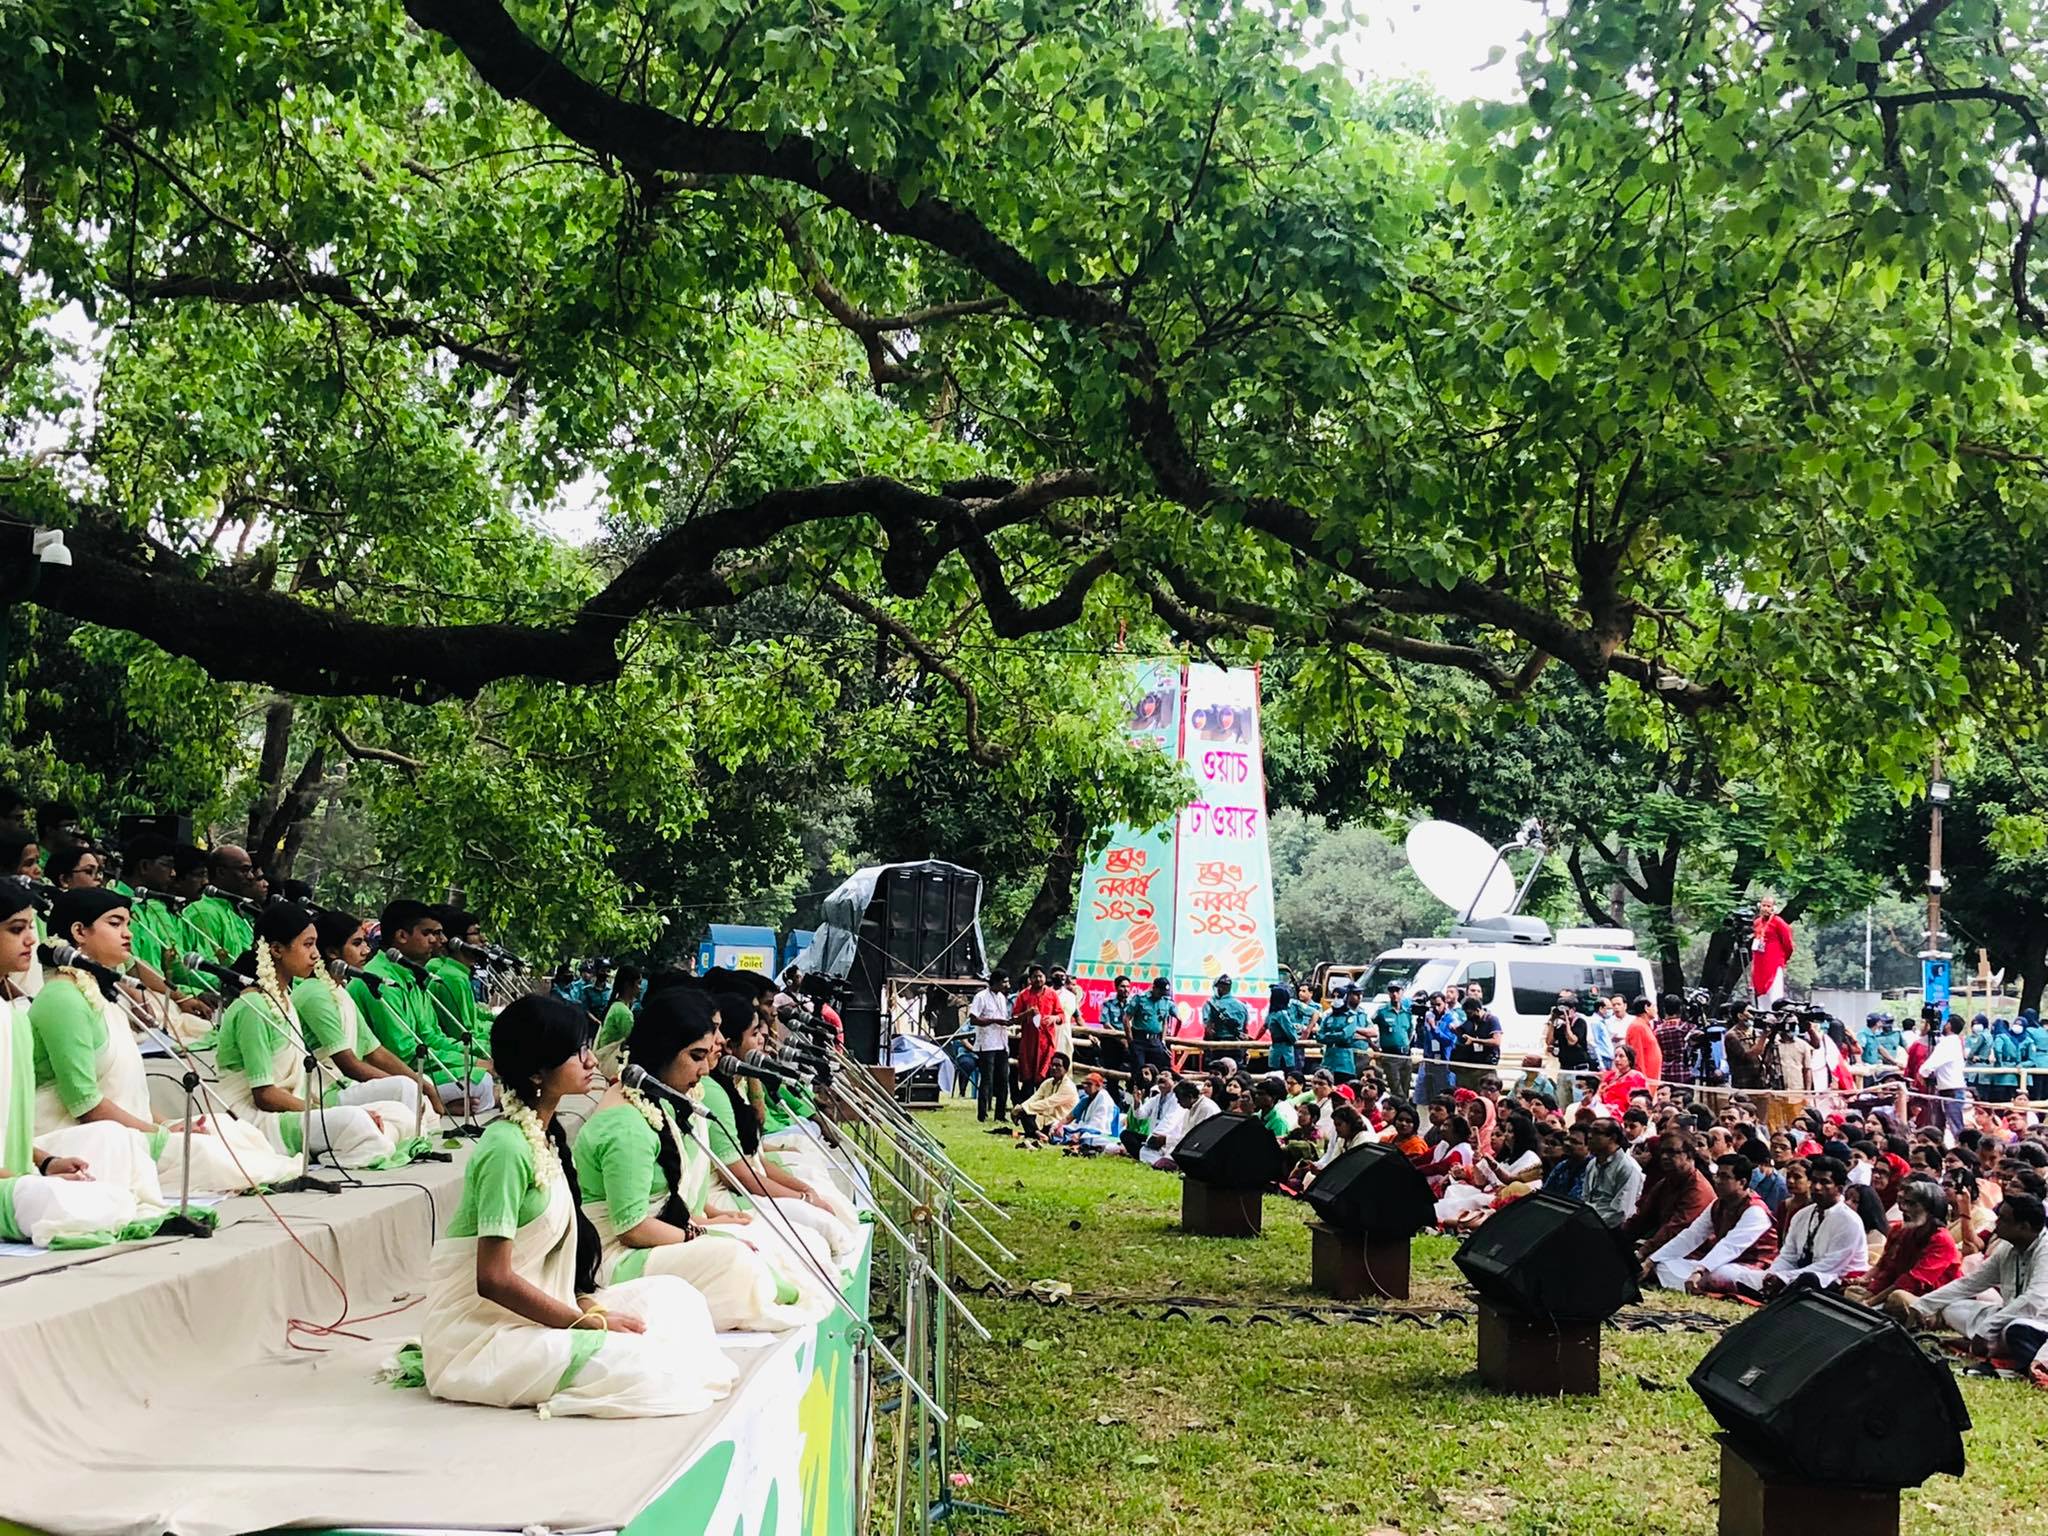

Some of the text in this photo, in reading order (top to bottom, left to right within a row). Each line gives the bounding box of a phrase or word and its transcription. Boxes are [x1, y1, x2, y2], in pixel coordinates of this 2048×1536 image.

[1202, 751, 1248, 784] ওয়াচ
[1187, 798, 1258, 840] টাওয়ার
[1106, 848, 1147, 875] শুভ
[1195, 861, 1242, 890] শুভ
[1095, 868, 1160, 897] নববর্ষ
[1189, 885, 1258, 912] নববর্ষ
[740, 960, 763, 968] Toilet
